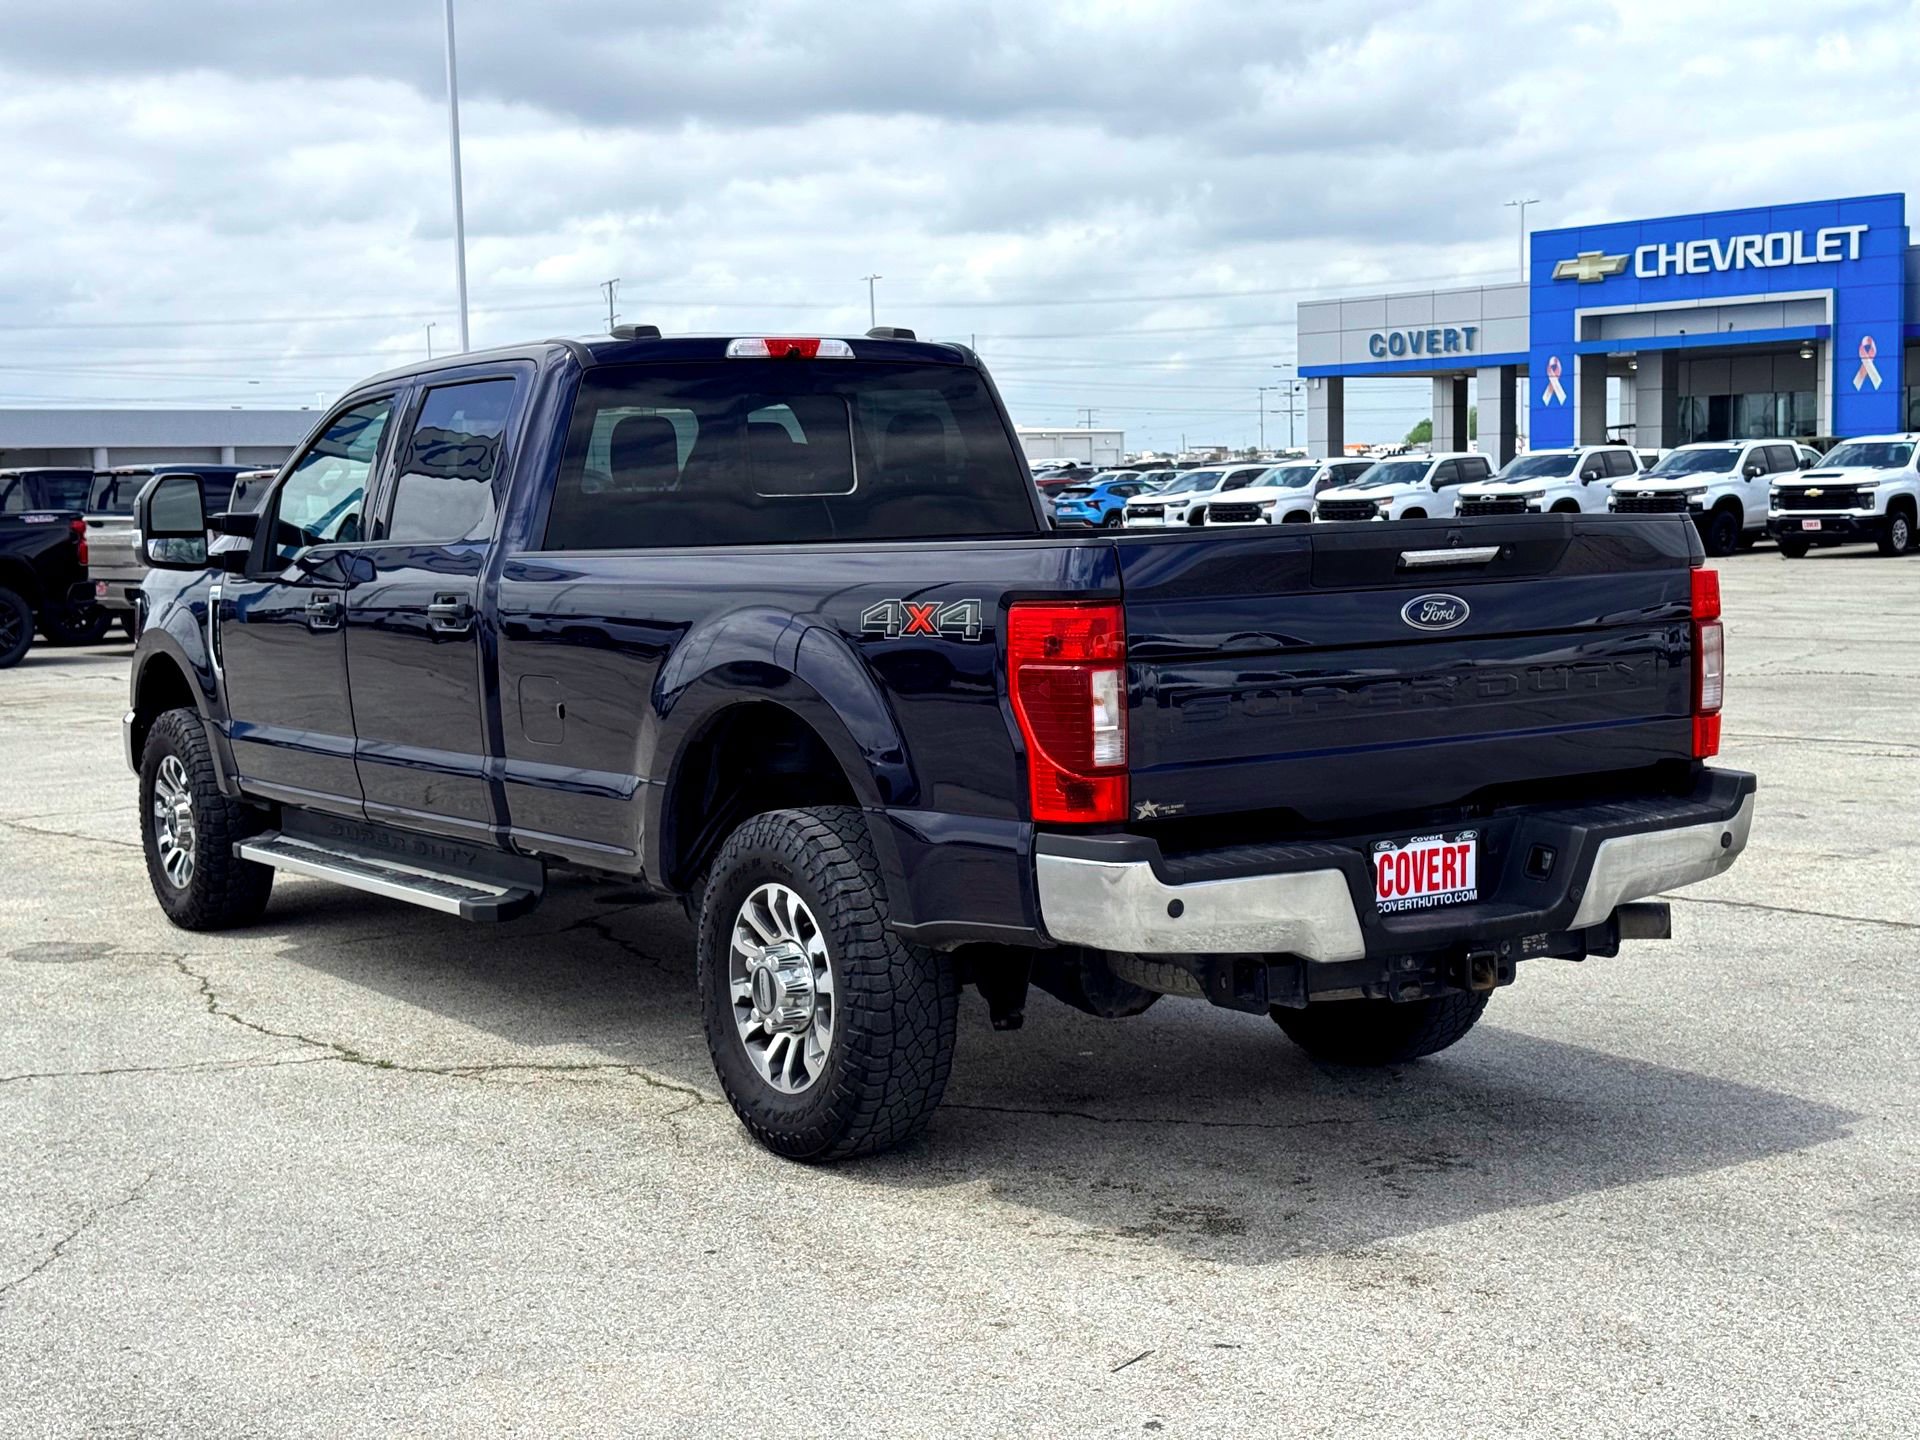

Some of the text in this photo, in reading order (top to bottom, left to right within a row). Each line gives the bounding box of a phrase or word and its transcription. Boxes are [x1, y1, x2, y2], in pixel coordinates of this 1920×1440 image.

[1635, 224, 1868, 278] CHEVROLET
[1368, 326, 1478, 358] COVERT
[1420, 600, 1457, 622] Ford
[1476, 661, 1652, 699] DUTY
[1410, 833, 1444, 844] Covert
[1378, 844, 1471, 898] COVERT
[1376, 889, 1478, 914] COVERTHUTTO.COM
